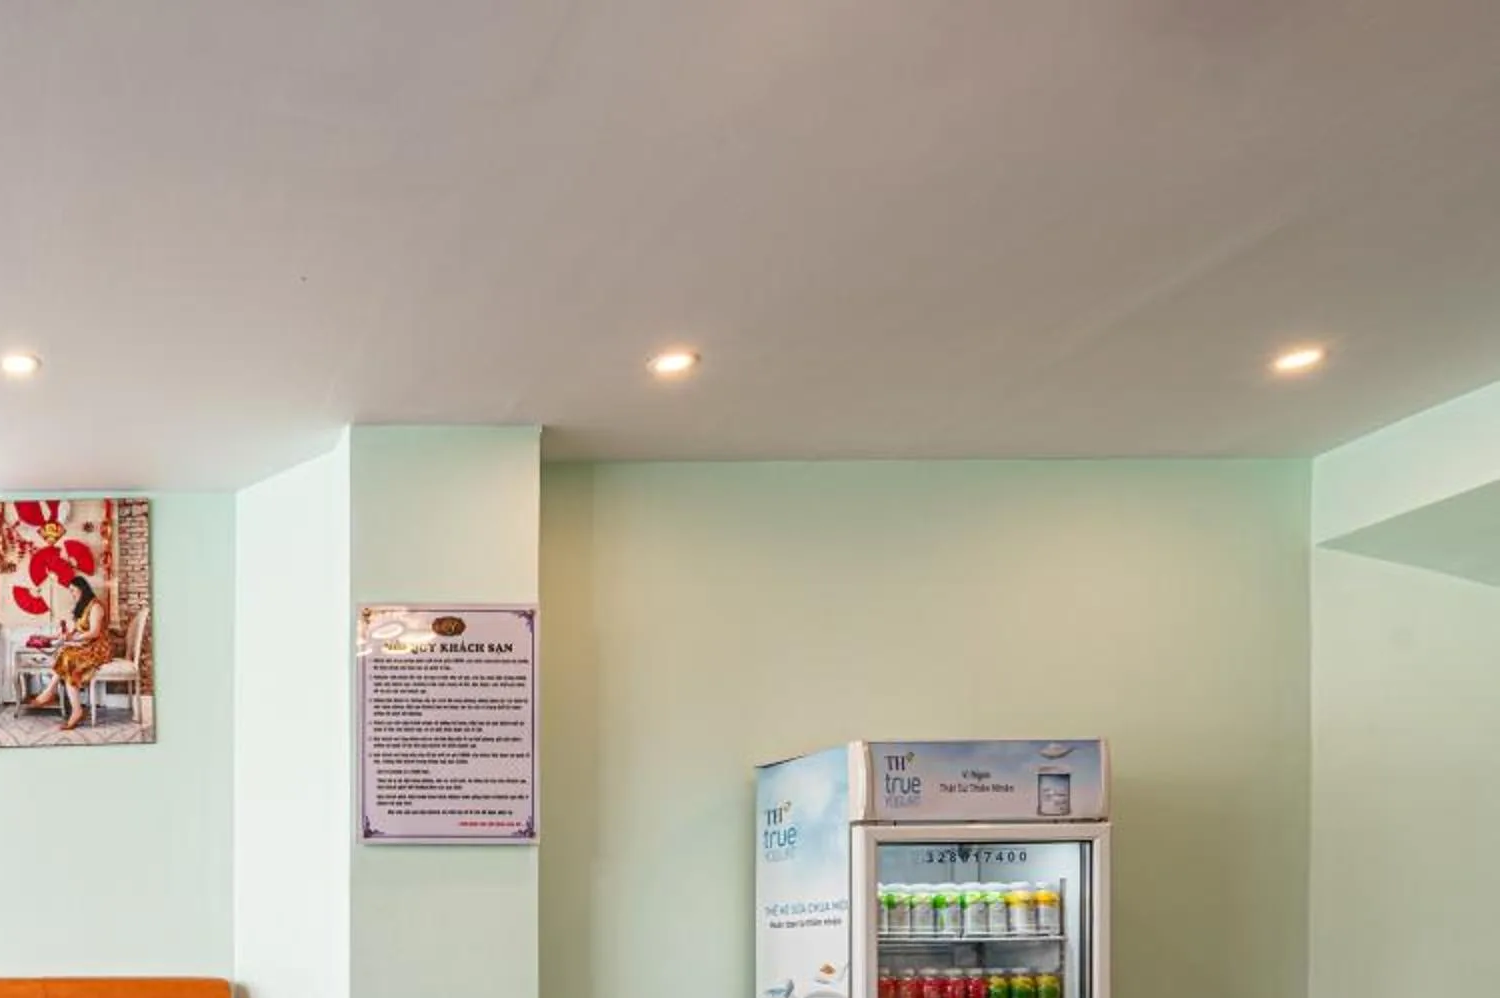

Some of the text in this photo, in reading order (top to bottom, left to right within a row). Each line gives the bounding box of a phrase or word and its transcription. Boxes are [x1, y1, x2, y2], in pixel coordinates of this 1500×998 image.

[440, 638, 484, 653] KHÁCH
[487, 643, 513, 656] SẠN
[885, 773, 922, 794] true
[764, 826, 797, 848] true
